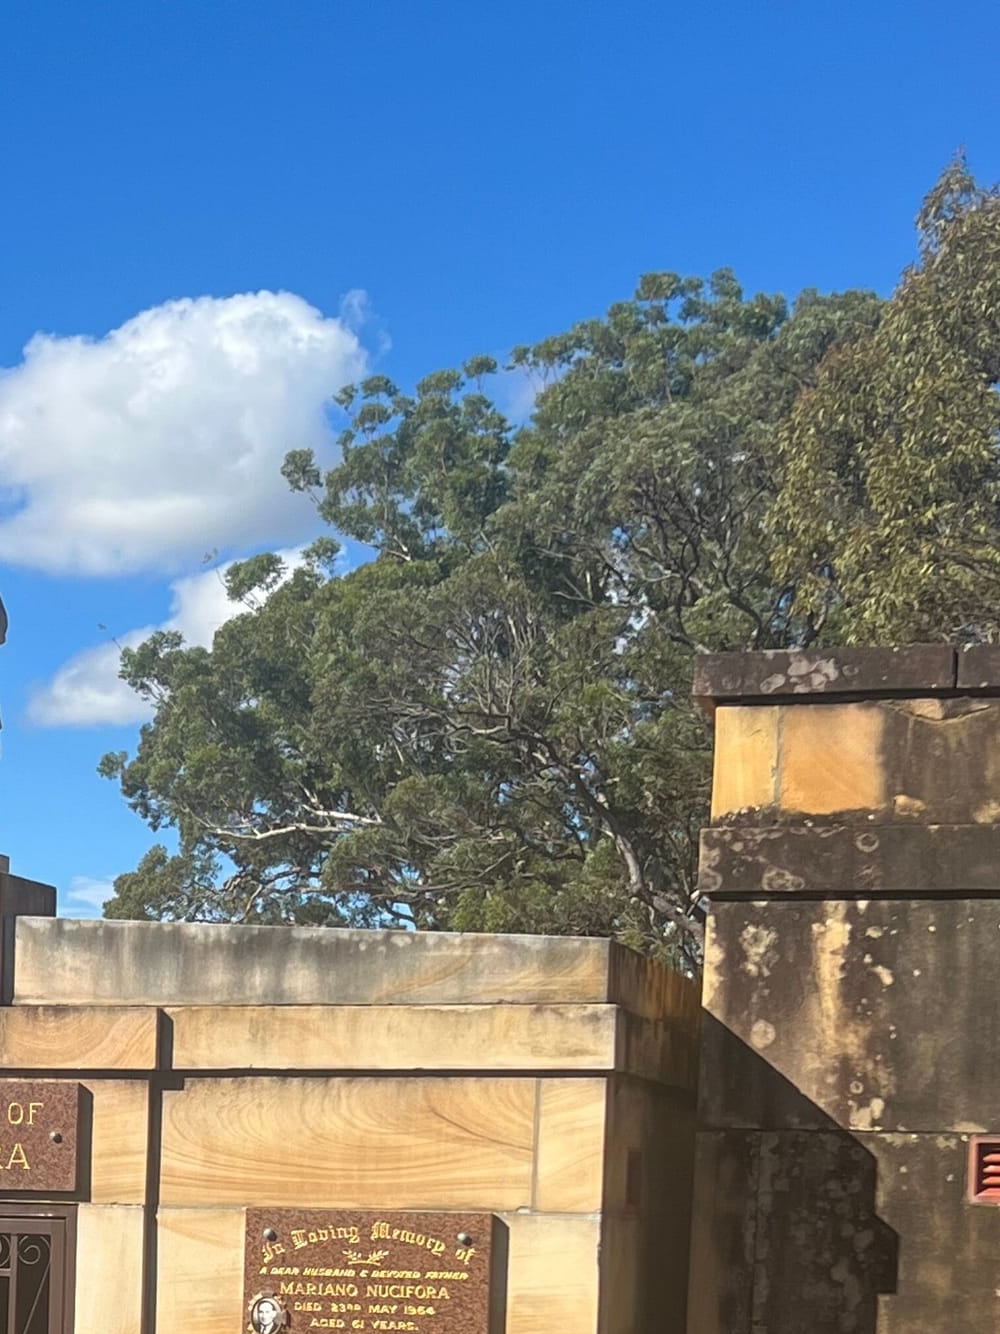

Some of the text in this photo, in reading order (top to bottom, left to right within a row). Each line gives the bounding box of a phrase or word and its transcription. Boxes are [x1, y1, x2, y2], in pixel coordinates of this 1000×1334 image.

[7, 1102, 44, 1125] OF
[262, 1221, 477, 1265] In Loving Memory of
[270, 1268, 299, 1276] DEAR
[303, 1268, 355, 1278] HUSBAND
[371, 1270, 420, 1279] DEVOTED
[425, 1272, 469, 1280] FATHER
[280, 1281, 450, 1299] MARIANO NUCIFORA
[294, 1302, 322, 1312] DIED
[368, 1304, 398, 1314] MAY
[310, 1318, 345, 1328] AGED
[371, 1320, 419, 1331] YEARS.
